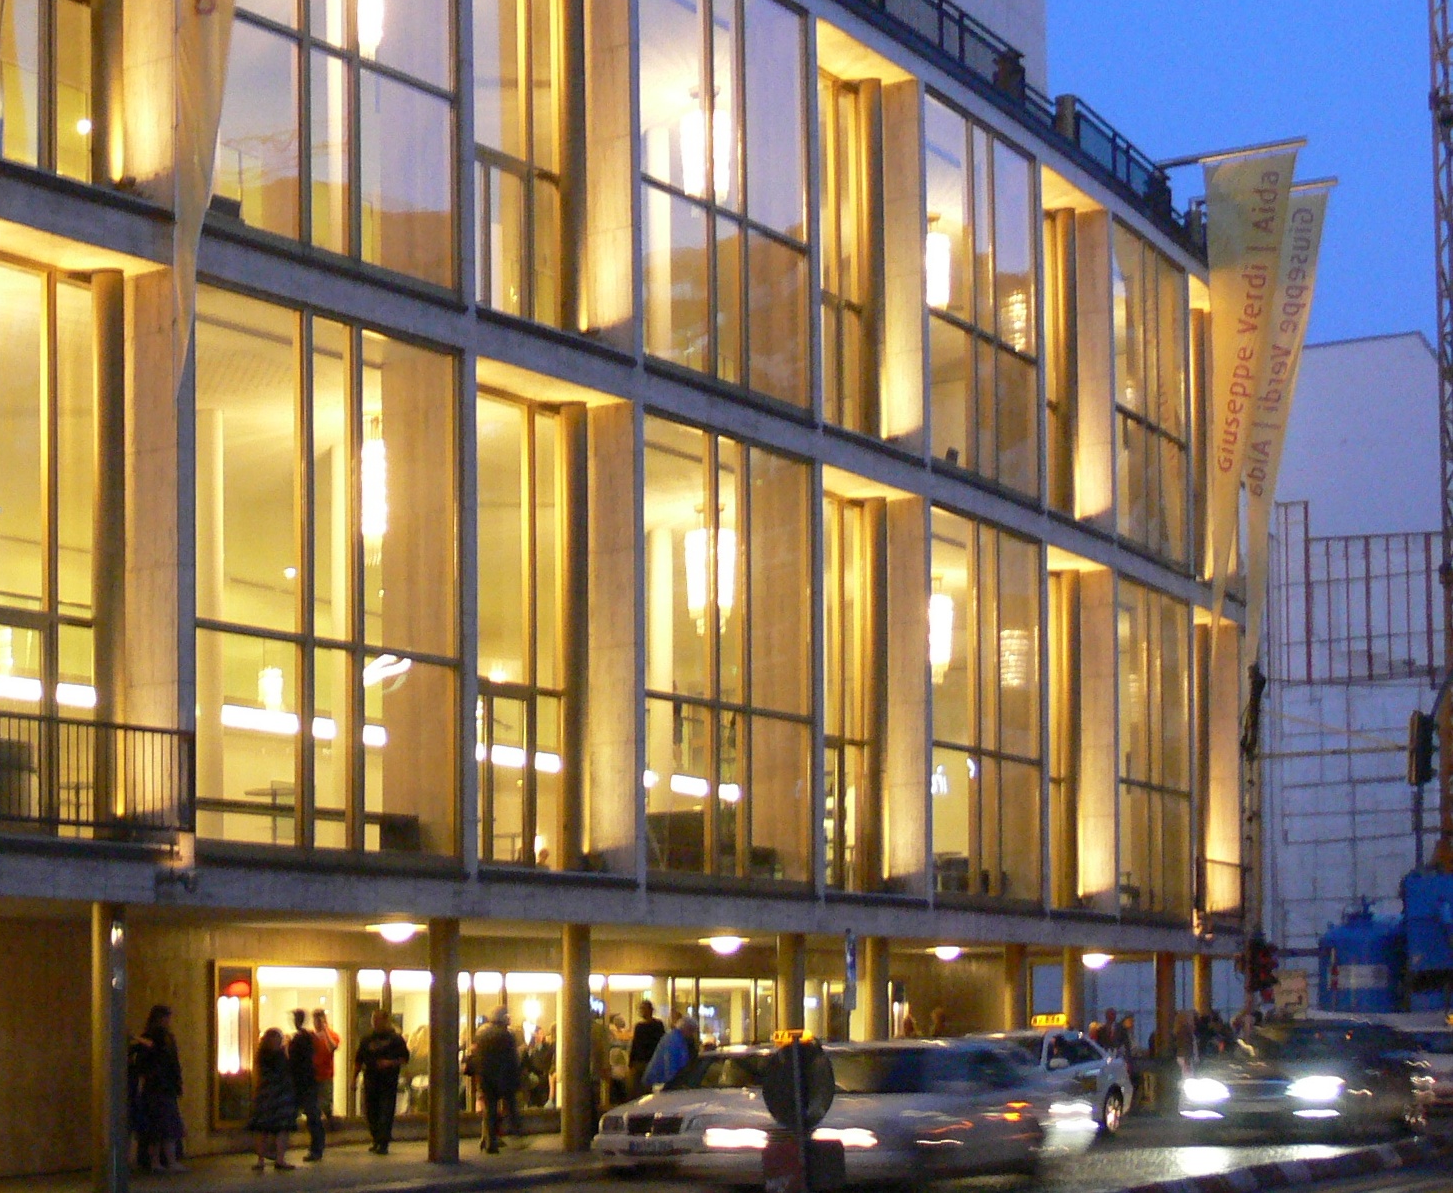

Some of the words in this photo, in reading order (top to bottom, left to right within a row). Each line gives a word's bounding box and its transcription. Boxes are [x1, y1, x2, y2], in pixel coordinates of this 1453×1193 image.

[1252, 170, 1280, 234] Aida
[1237, 263, 1268, 336] Verdi
[1219, 347, 1255, 473] Giuseppe
